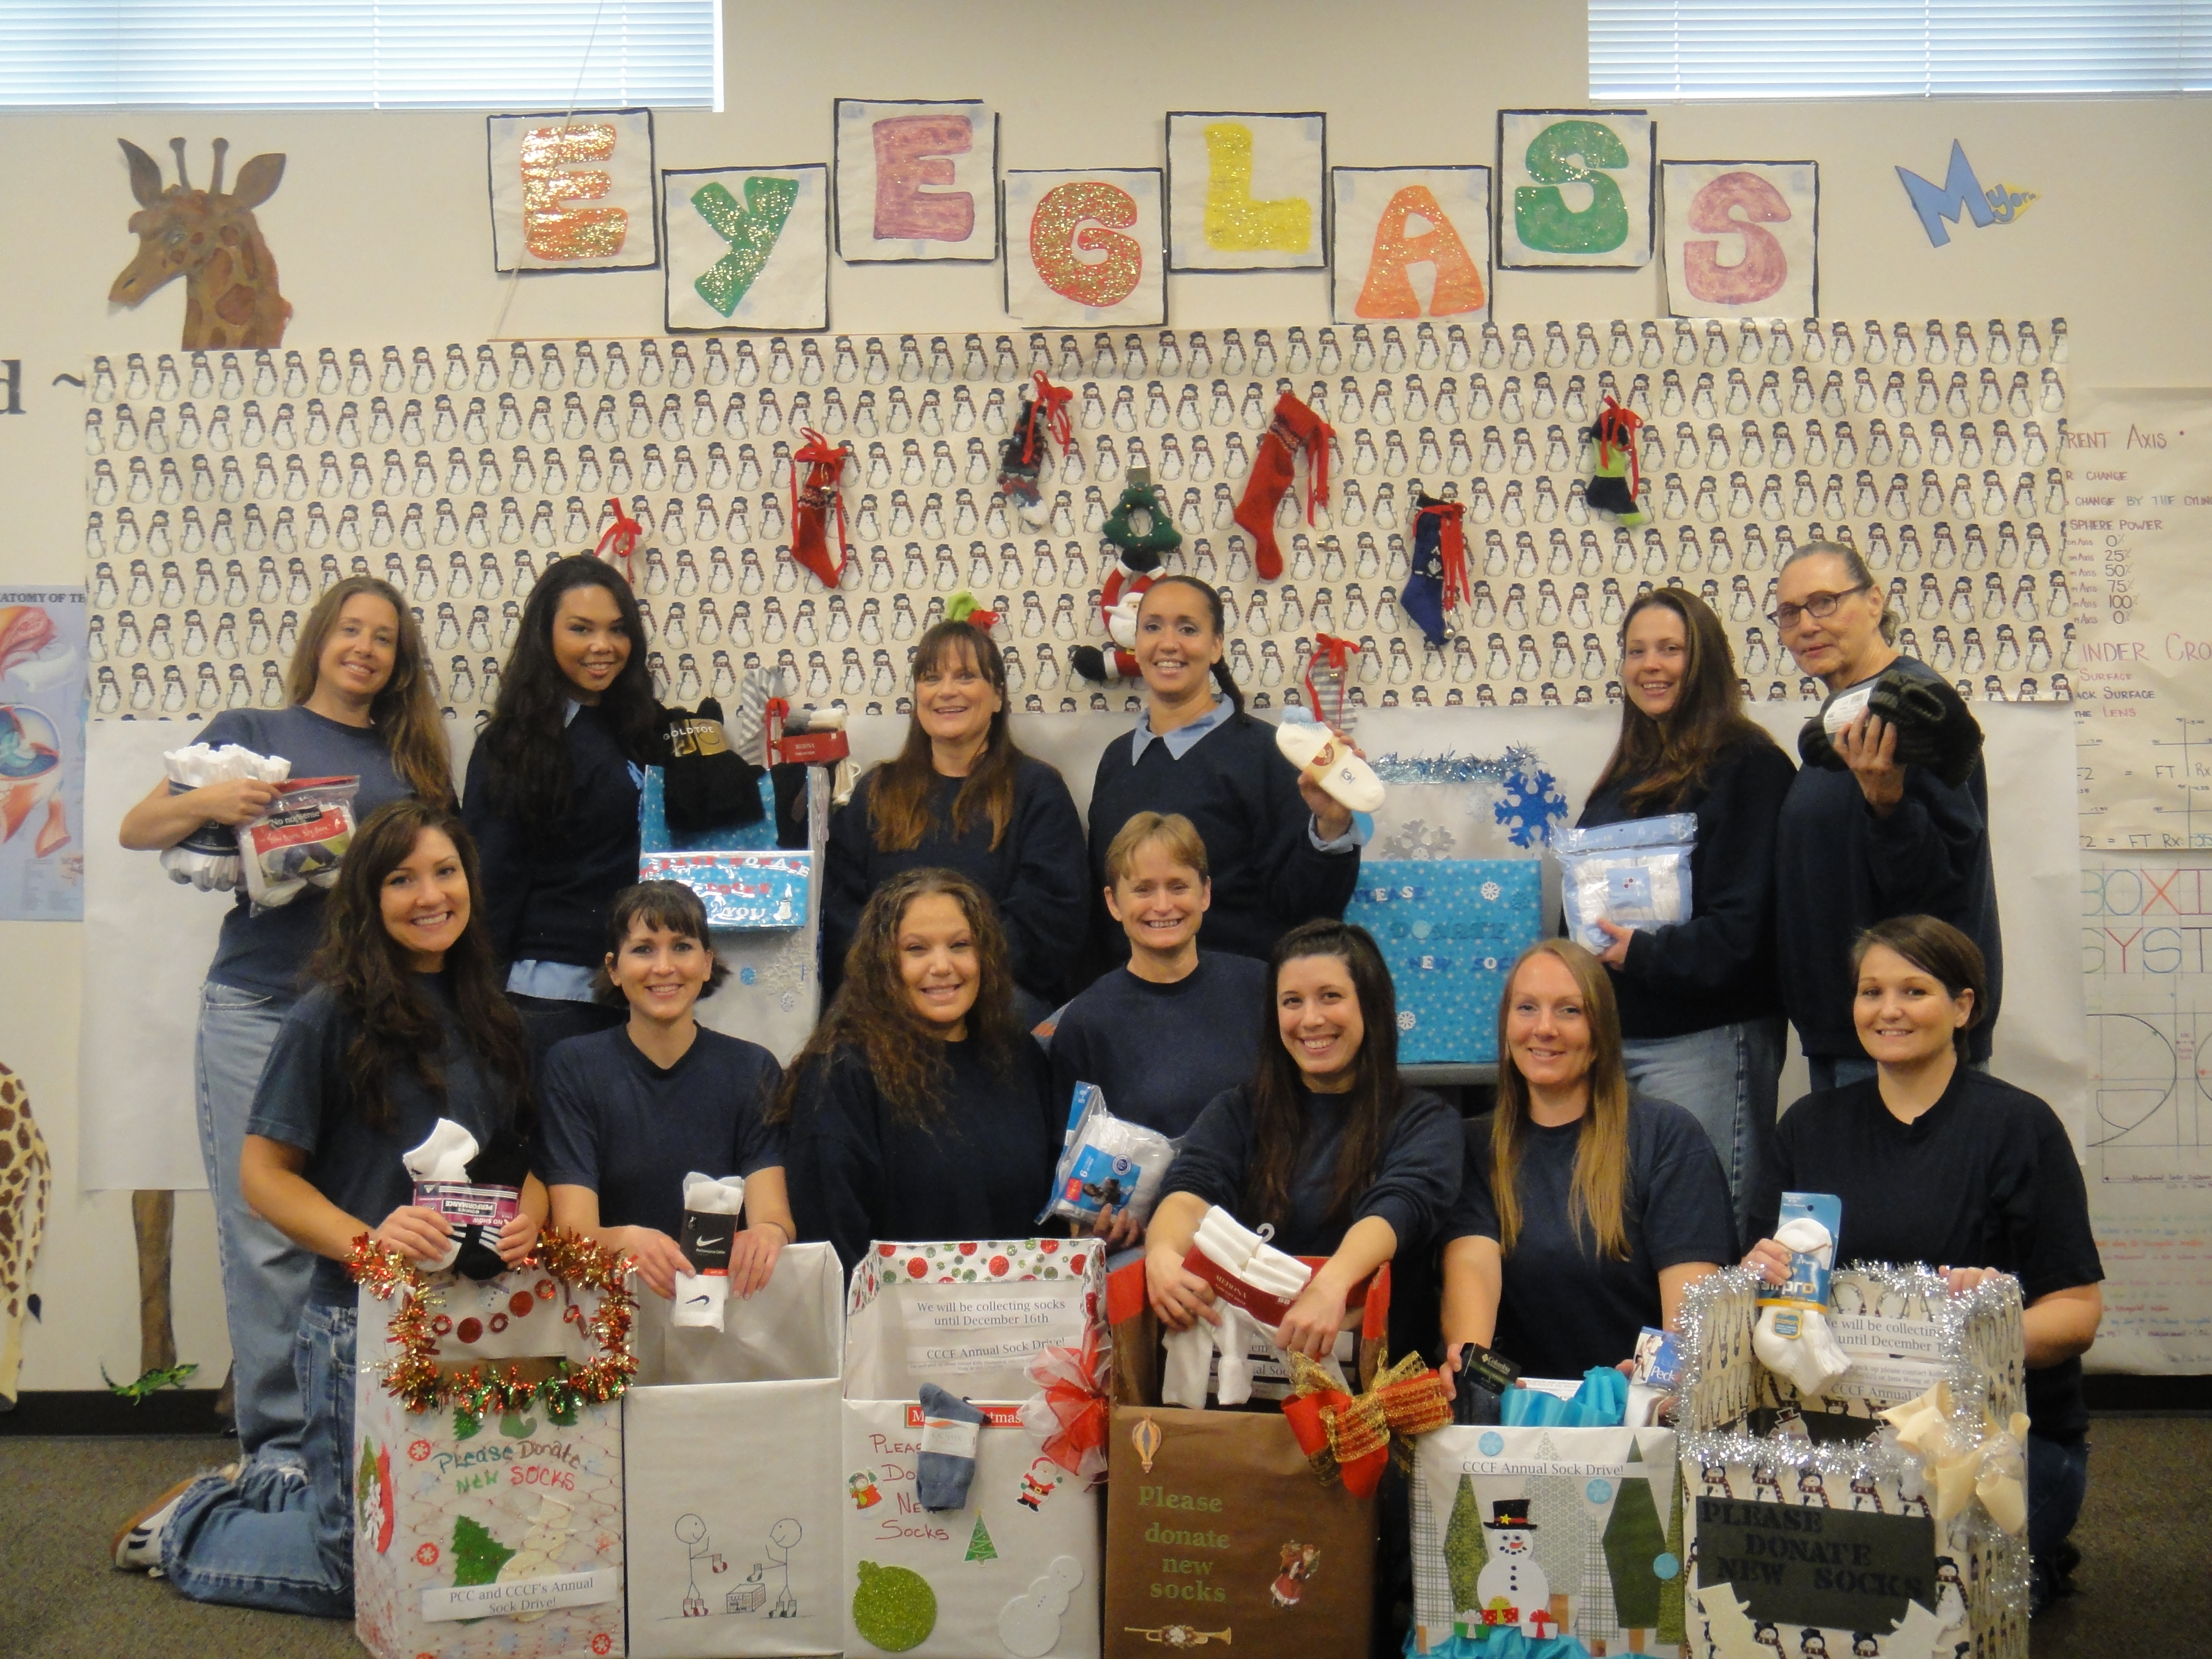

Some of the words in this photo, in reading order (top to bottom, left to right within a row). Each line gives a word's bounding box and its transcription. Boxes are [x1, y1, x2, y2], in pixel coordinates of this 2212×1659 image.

[2085, 471, 2128, 481] CHANGE
[2075, 497, 2115, 506] CHANGE
[2127, 496, 2143, 506] BY
[2070, 519, 2114, 531] SPHERE
[2119, 519, 2163, 531] POWER
[48, 593, 65, 603] OF
[2079, 642, 2150, 662] INDER
[2166, 633, 2212, 661] CRO
[2103, 686, 2156, 700] SURFACE
[2103, 706, 2137, 718] LENS
[2155, 765, 2175, 779] FT
[2128, 833, 2152, 847] FT
[729, 857, 810, 877] DONATE
[1353, 886, 1426, 902] PLEASE
[445, 1200, 493, 1211] PERFORMANCE
[917, 1302, 933, 1312] We
[937, 1302, 956, 1312] will
[959, 1301, 972, 1312] be
[976, 1300, 1030, 1312] collecting
[1034, 1299, 1066, 1311] socks
[934, 1315, 959, 1326] until
[963, 1314, 1019, 1326] December
[1024, 1313, 1048, 1324] 16th
[1841, 1318, 1863, 1331] will
[1867, 1319, 1882, 1332] be
[1885, 1319, 1937, 1337] collectin
[927, 1348, 956, 1360] CCCF
[960, 1344, 999, 1359] Annual
[1003, 1341, 1029, 1354] Sock
[1838, 1334, 1867, 1345] until
[1871, 1335, 1932, 1352] December
[1831, 1385, 1865, 1396] CCCF
[1869, 1386, 1912, 1401] Annual
[869, 1433, 922, 1454] PLEAS
[1463, 1461, 1497, 1474] CCCF
[1503, 1460, 1547, 1475] Annual
[1552, 1462, 1581, 1475] Sock
[1586, 1464, 1624, 1476] Drive!
[1139, 1486, 1223, 1512] Please
[1701, 1500, 1823, 1533] PLEASE
[1144, 1522, 1231, 1549] donate
[1745, 1532, 1872, 1566] DONATE
[1162, 1558, 1214, 1575] new
[1717, 1556, 1786, 1585] NEW
[1813, 1567, 1924, 1598] SOCKS
[450, 1590, 476, 1603] PCC
[479, 1588, 501, 1600] and
[505, 1583, 547, 1598] CCCF's
[552, 1577, 593, 1593] Annual
[1150, 1579, 1226, 1603] socks
[489, 1601, 516, 1615] Sock
[521, 1597, 556, 1610] Drive!
